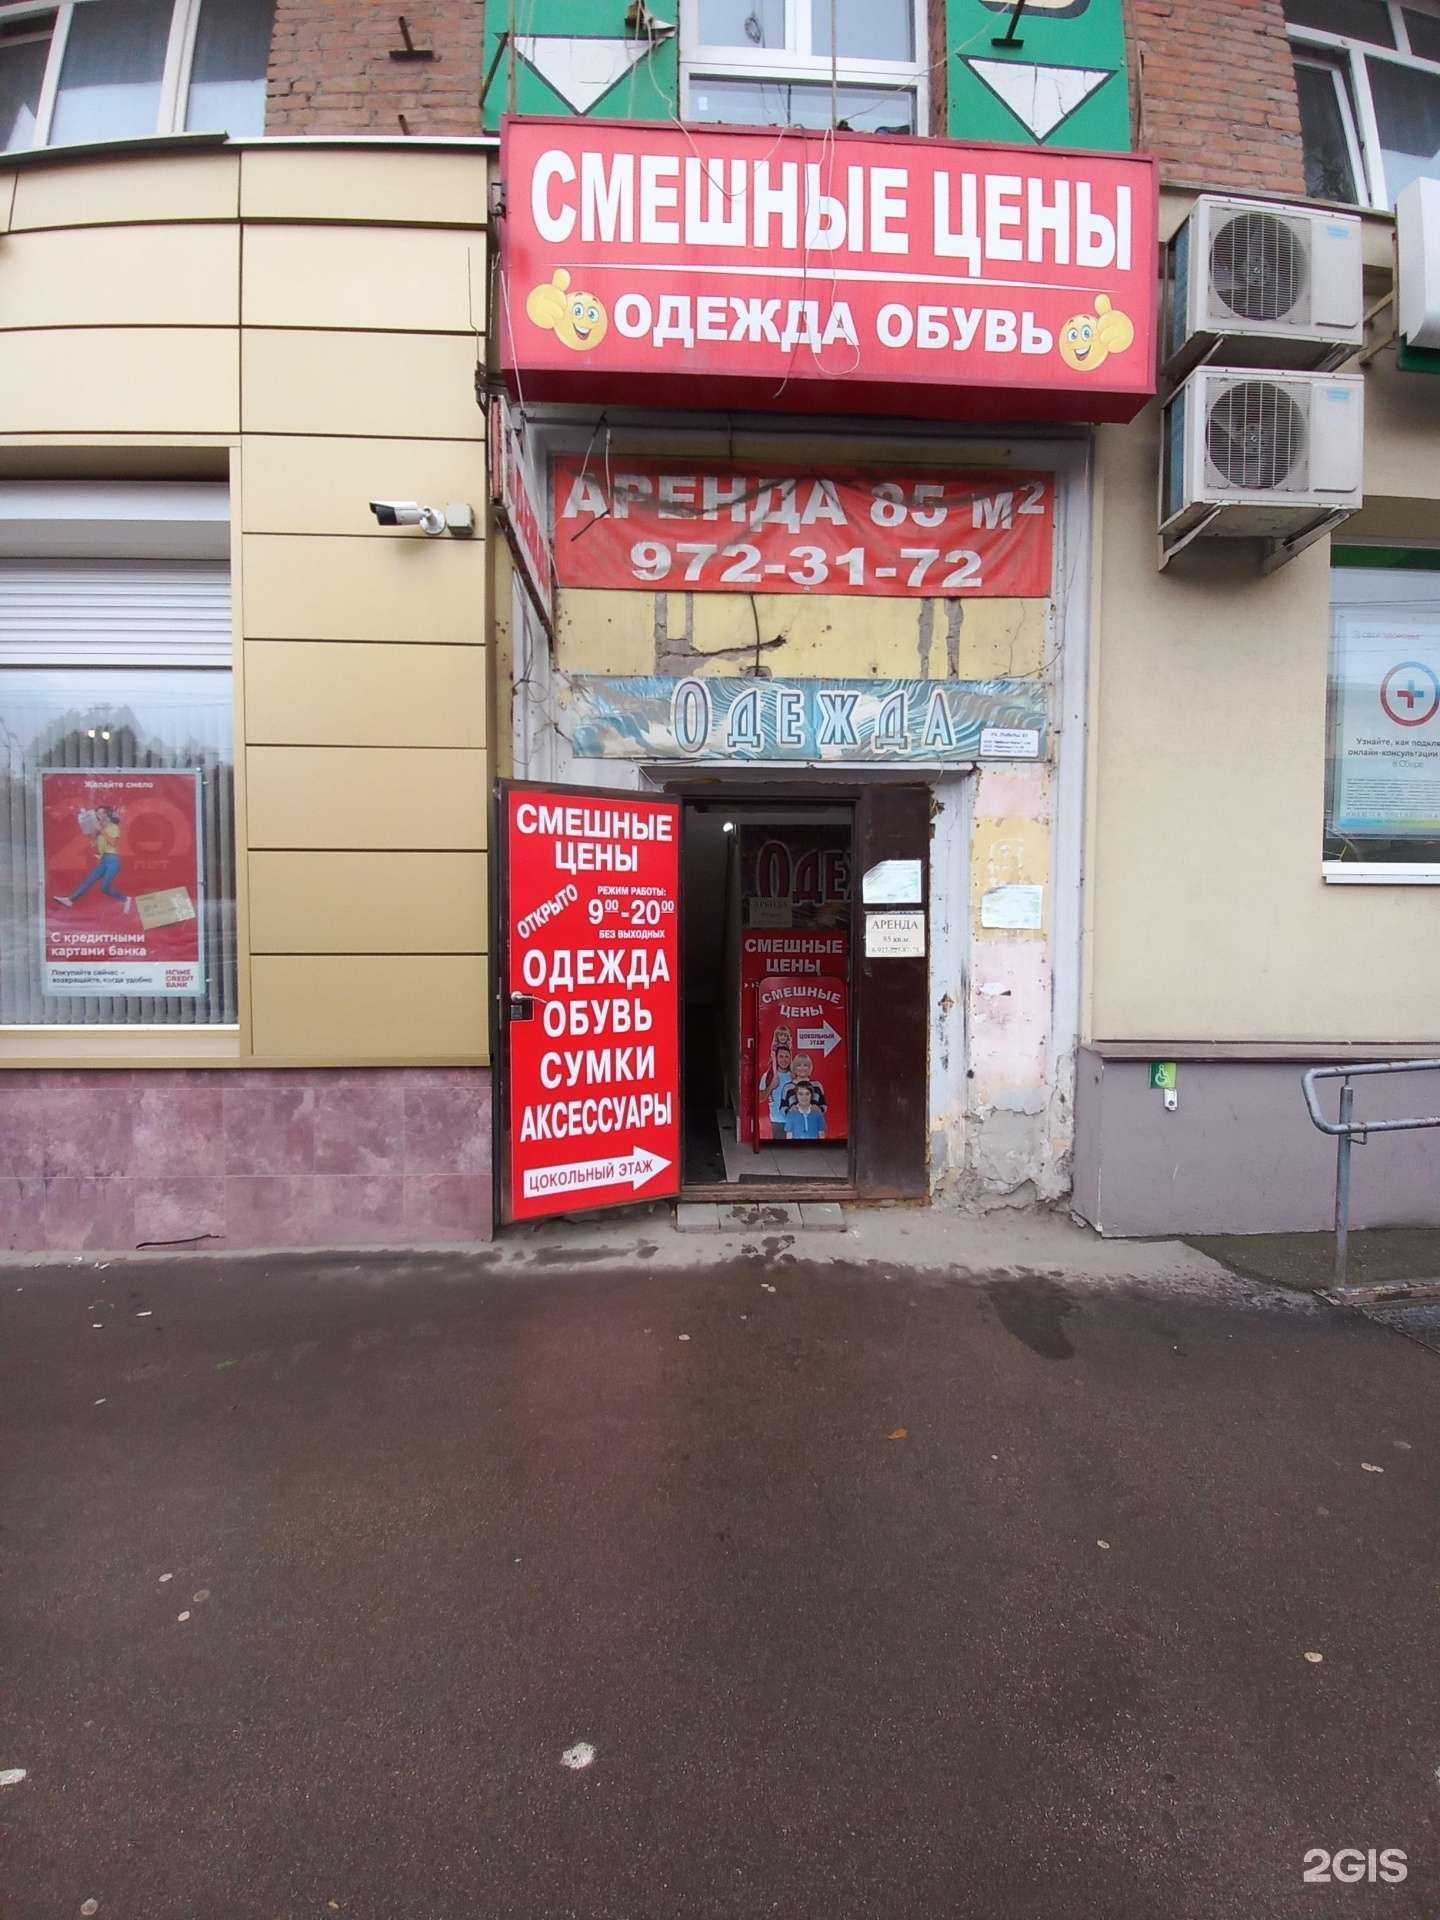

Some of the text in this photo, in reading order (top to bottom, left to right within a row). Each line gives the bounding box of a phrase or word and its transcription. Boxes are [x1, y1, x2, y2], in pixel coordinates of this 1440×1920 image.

[531, 149, 1132, 276] СМЕШНЫЕ ЦЕНЫ
[613, 293, 1053, 355] ОДЕЖДА ОБУВЬ
[563, 473, 848, 534] АРЕНДА
[871, 483, 947, 527] 85
[630, 541, 983, 588] 972-31-72
[674, 680, 955, 753] ОДЕЖДА
[516, 803, 673, 842] СМЕШНЫЕ
[555, 840, 638, 876] ЦЕНЫ
[597, 885, 667, 897] РЕЖИМ РАБОТЫ:
[517, 884, 579, 939] ОТКРЫТО
[872, 919, 919, 930] АРЕНДА
[51, 932, 145, 945] С кредитными
[52, 946, 147, 958] картами банка
[599, 930, 665, 940] БЕЗ ВЫХОДНЫХ
[745, 939, 843, 954] СМЕШНЫЕ
[522, 948, 670, 994] ОДЕЖДА
[766, 958, 822, 976] ЦЕНЫ
[762, 986, 841, 1004] СМЕШНЫЕ
[780, 1005, 823, 1018] ЦЕНЫ
[543, 999, 653, 1038] ОБУВЬ
[540, 1045, 655, 1090] СУМКИ
[520, 1091, 672, 1143] АКСЕССУАРЫ
[529, 1158, 654, 1192] ЦОКОЛЬНЫЙ ЭТАЖ
